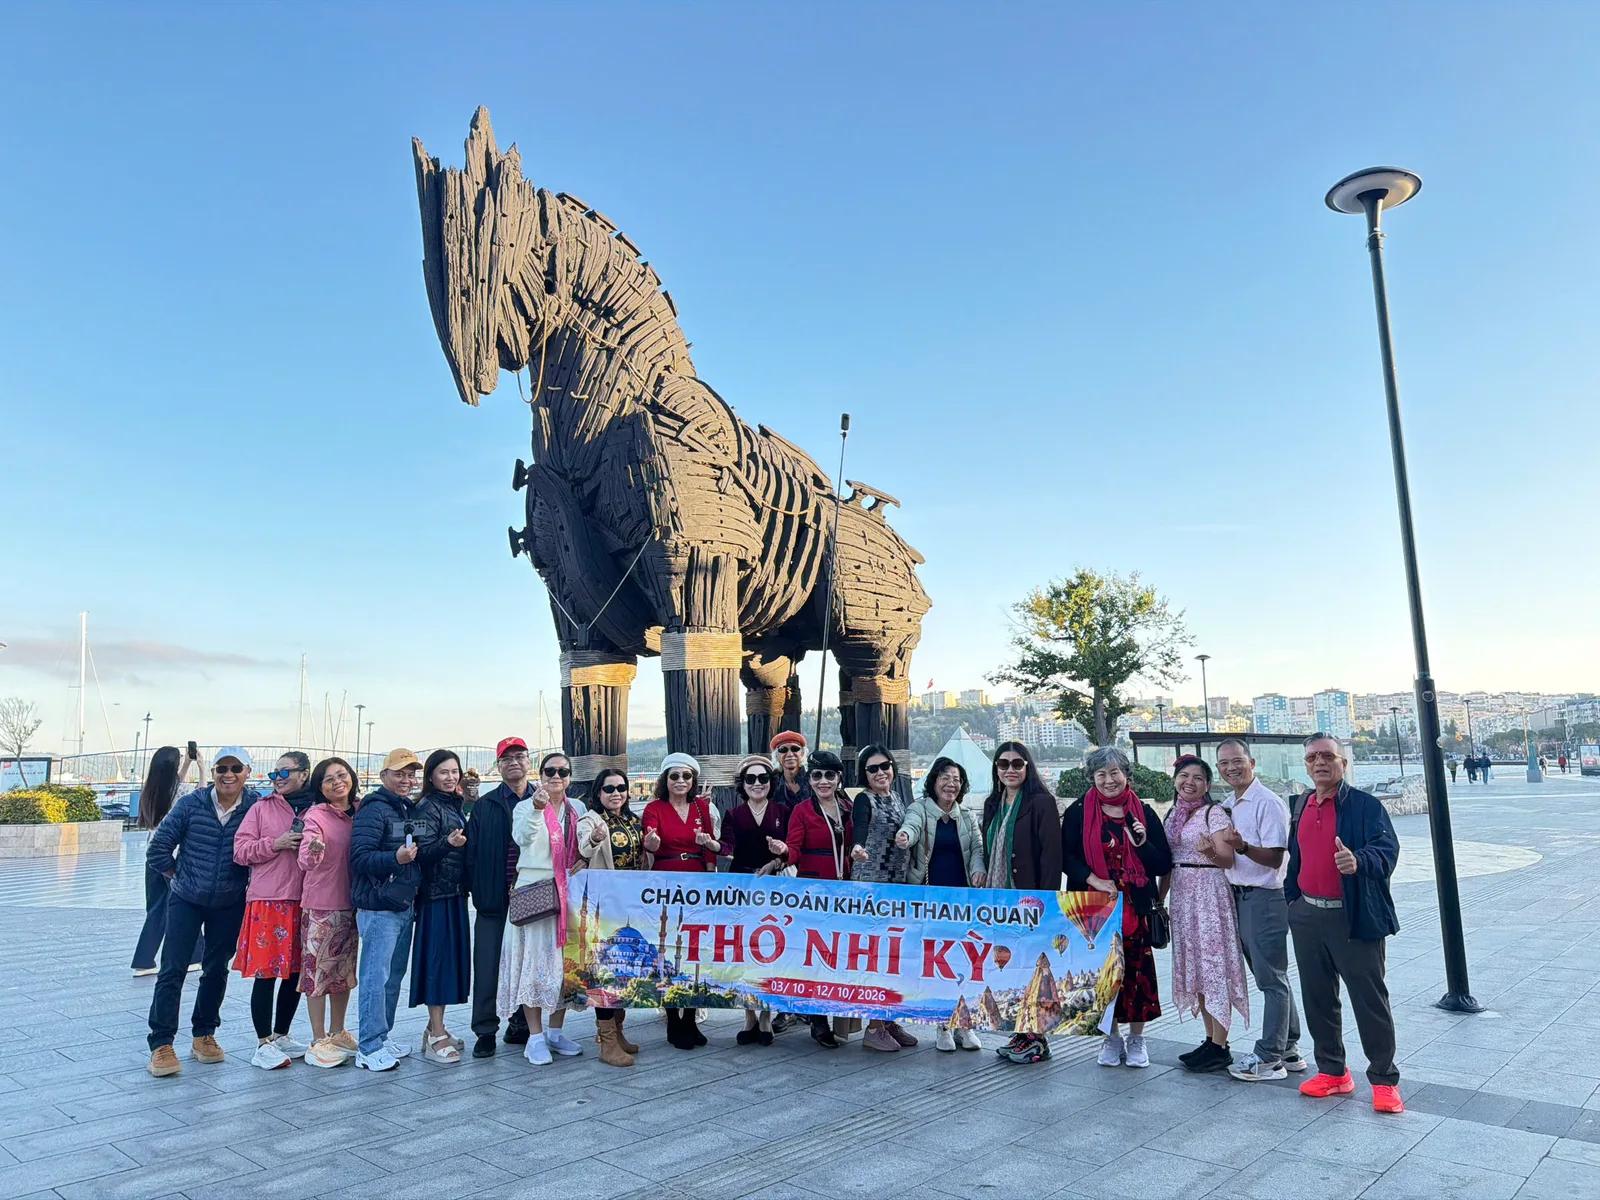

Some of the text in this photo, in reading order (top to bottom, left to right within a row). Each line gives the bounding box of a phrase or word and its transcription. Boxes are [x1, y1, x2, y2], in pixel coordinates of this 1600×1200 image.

[640, 885, 1039, 926] CHÀO MỪNG ĐOÀN KHÁCH THAM QUAN
[680, 914, 993, 982] THỔ NHĨ KỲ
[857, 988, 886, 1001] 2026
